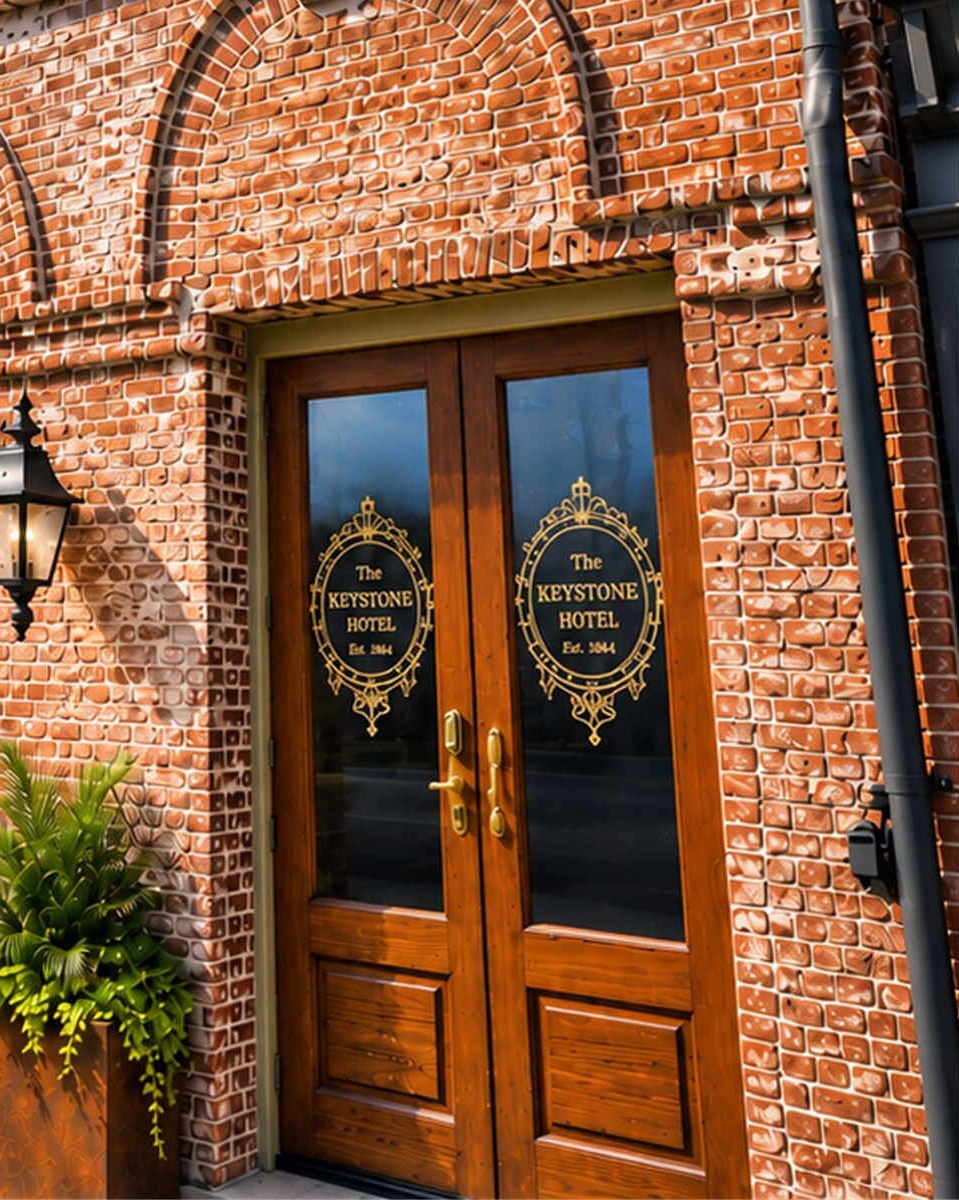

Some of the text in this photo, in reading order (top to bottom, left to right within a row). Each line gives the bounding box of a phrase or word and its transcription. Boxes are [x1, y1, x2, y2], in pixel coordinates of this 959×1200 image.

[570, 553, 602, 571] The
[355, 564, 383, 581] The
[328, 590, 413, 609] KEYSTONE
[537, 582, 639, 603] KEYSTONE
[346, 616, 397, 632] HOTEL
[558, 610, 620, 629] HOTEL
